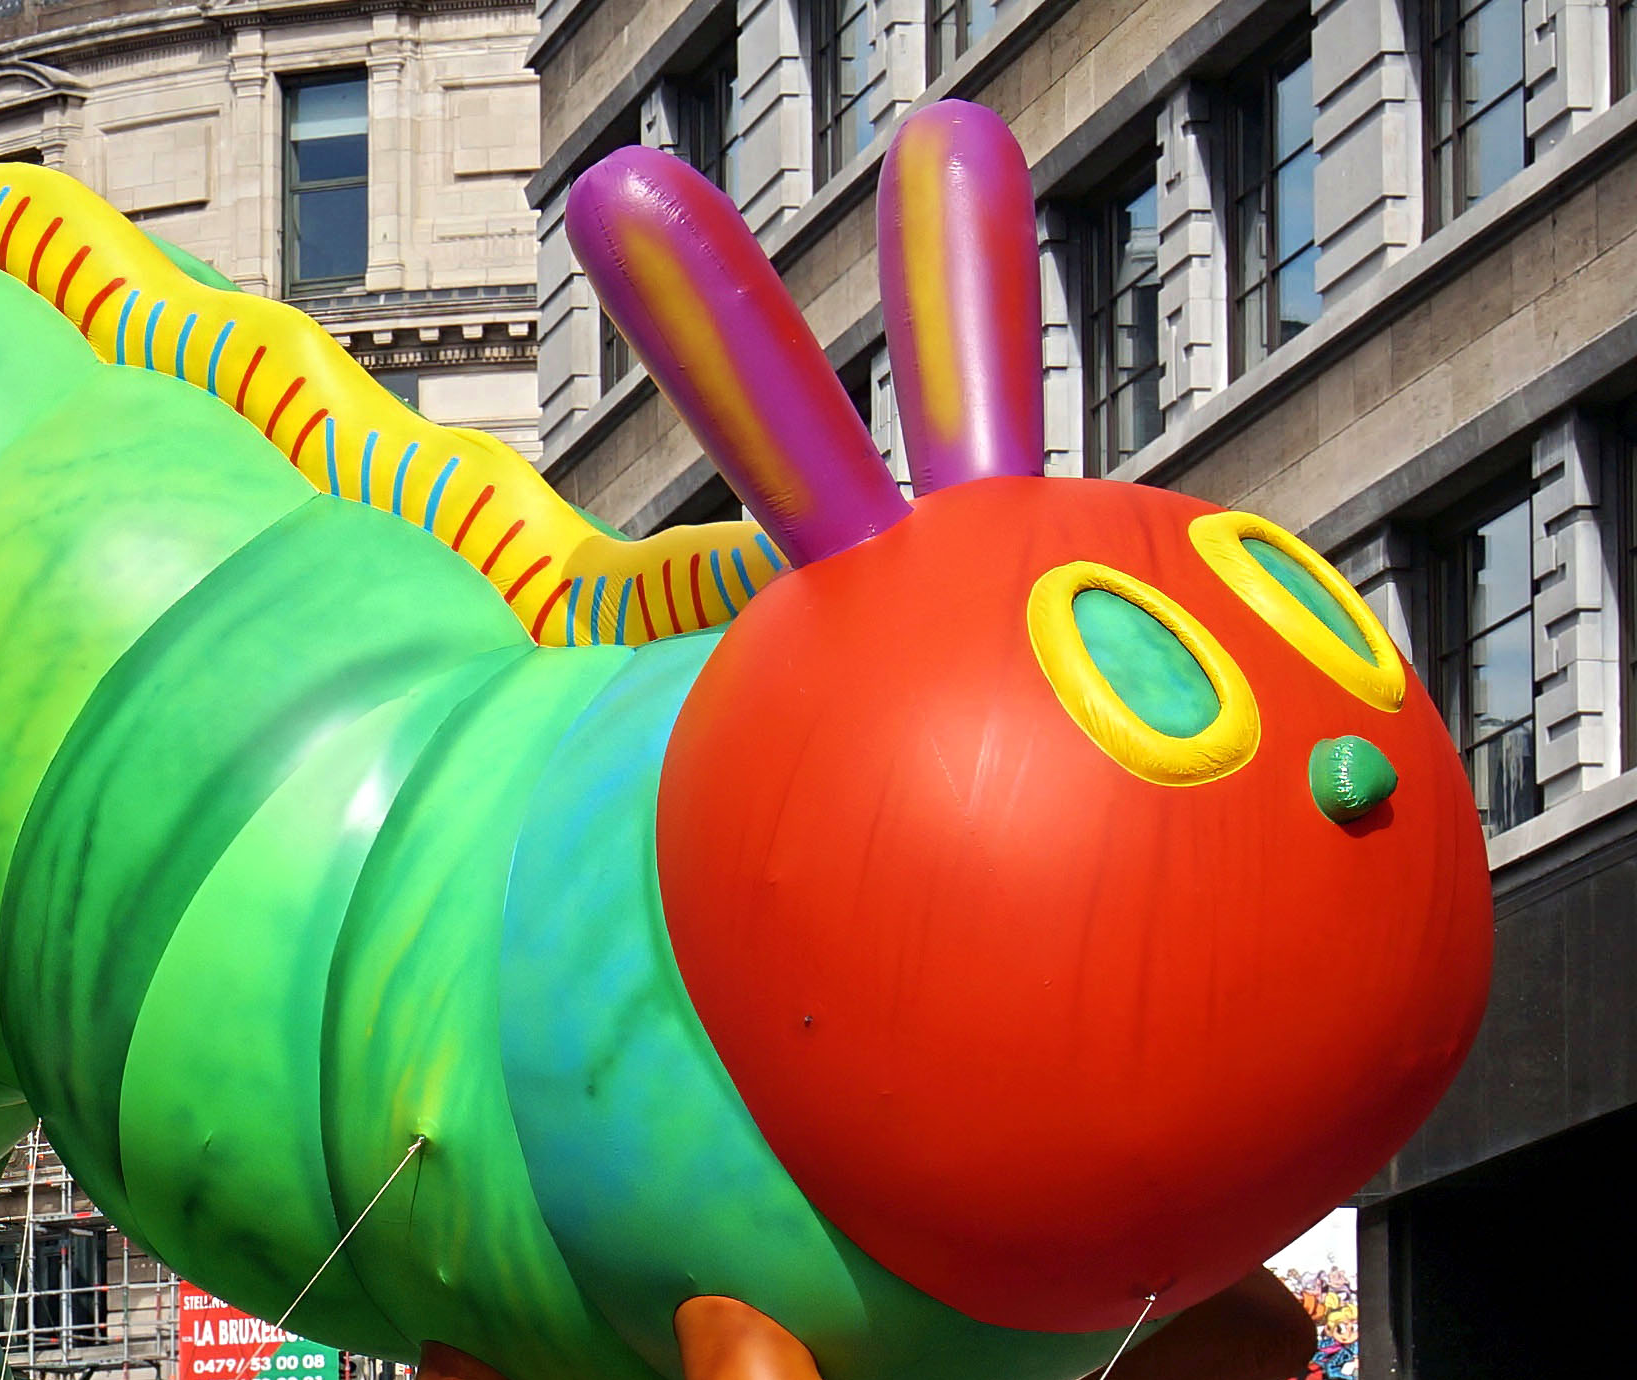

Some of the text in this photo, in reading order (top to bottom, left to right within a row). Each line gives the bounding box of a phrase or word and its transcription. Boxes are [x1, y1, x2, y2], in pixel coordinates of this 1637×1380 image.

[193, 1318, 305, 1346] LA BRUXELL
[193, 1354, 325, 1374] 0479/ 53 00 08
